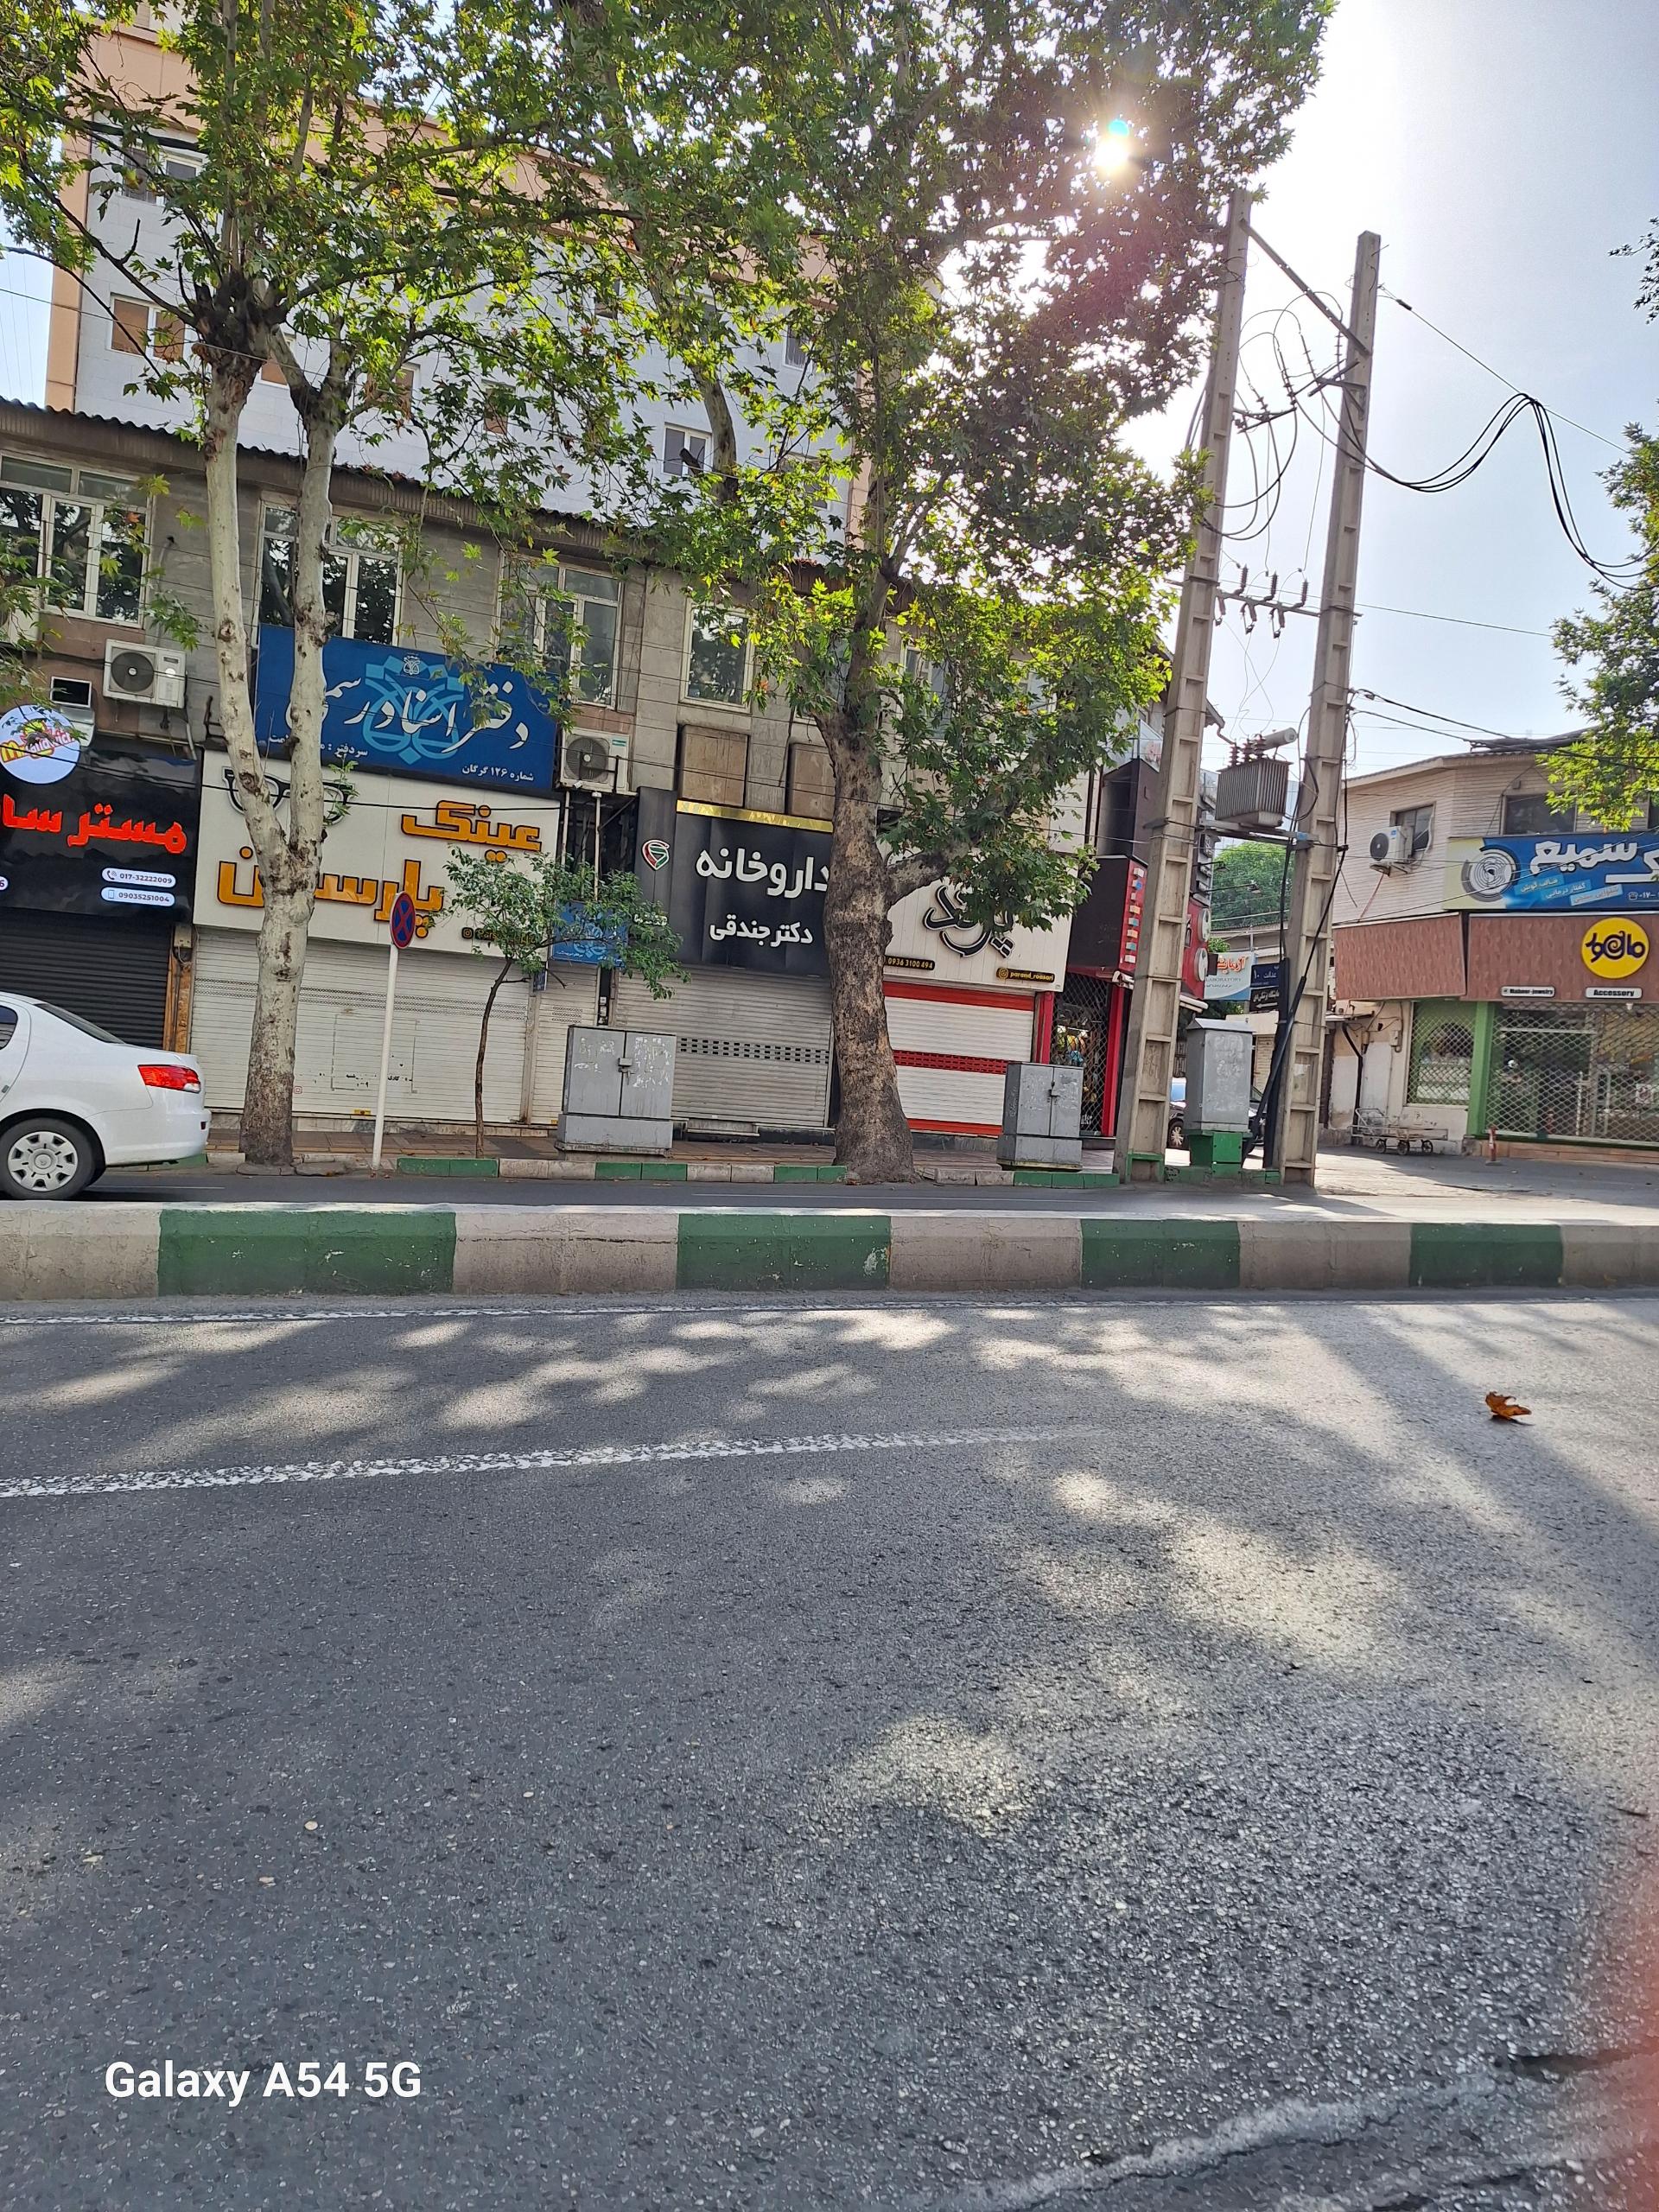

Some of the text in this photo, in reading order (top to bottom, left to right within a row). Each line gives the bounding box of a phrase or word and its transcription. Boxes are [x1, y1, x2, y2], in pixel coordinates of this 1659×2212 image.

[374, 689, 457, 736] اسناد
[442, 681, 529, 754] دفتر
[461, 764, 535, 781] شماره ۱۲۶ گرگان
[67, 803, 188, 854] مستر
[401, 800, 542, 863] عینک
[1530, 841, 1637, 874] سمیع
[119, 872, 173, 884] 017-32222009
[118, 891, 170, 903] 09035251004
[709, 913, 814, 948] دکتر جندقی
[887, 957, 905, 966] 0936
[905, 959, 920, 968] 3100
[1593, 988, 1635, 997] Accessory
